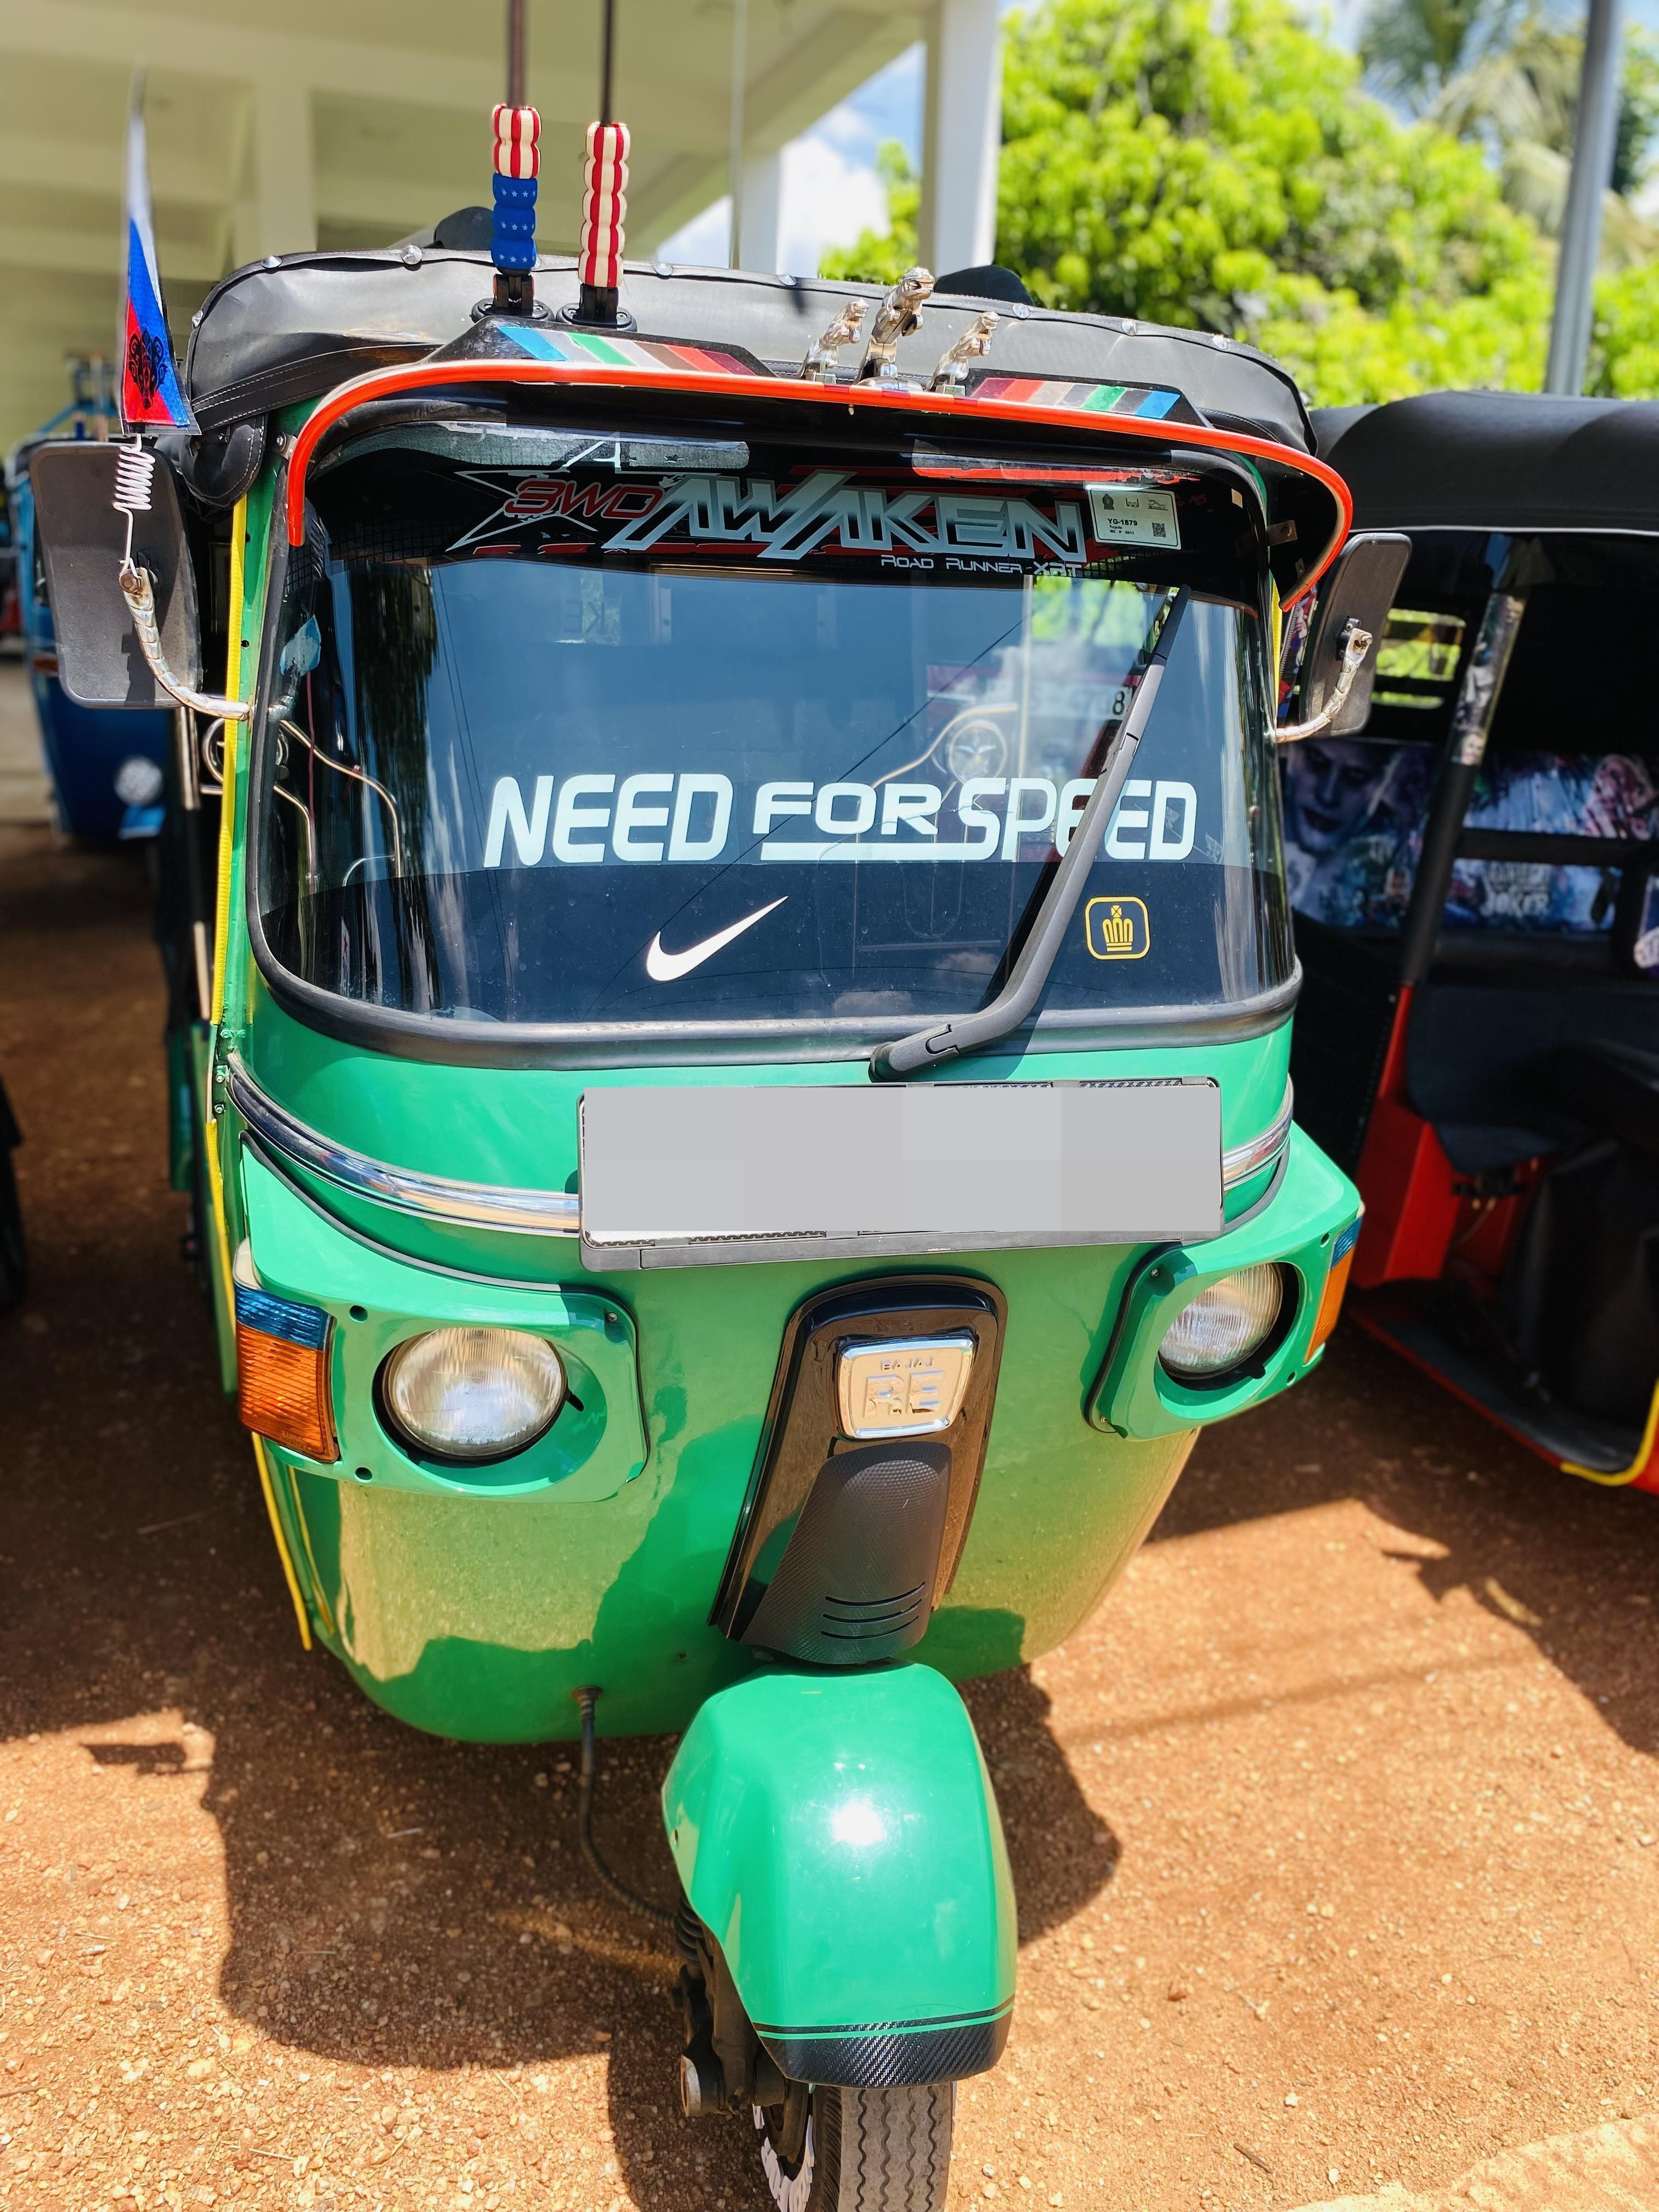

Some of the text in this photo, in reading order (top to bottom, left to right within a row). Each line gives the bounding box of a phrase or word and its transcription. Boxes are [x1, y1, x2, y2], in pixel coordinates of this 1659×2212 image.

[601, 470, 1087, 563] AWAKEN
[484, 774, 1197, 868] NEED FOR SPEED
[865, 1370, 944, 1418] RE
[882, 1356, 934, 1370] BAJAJ
